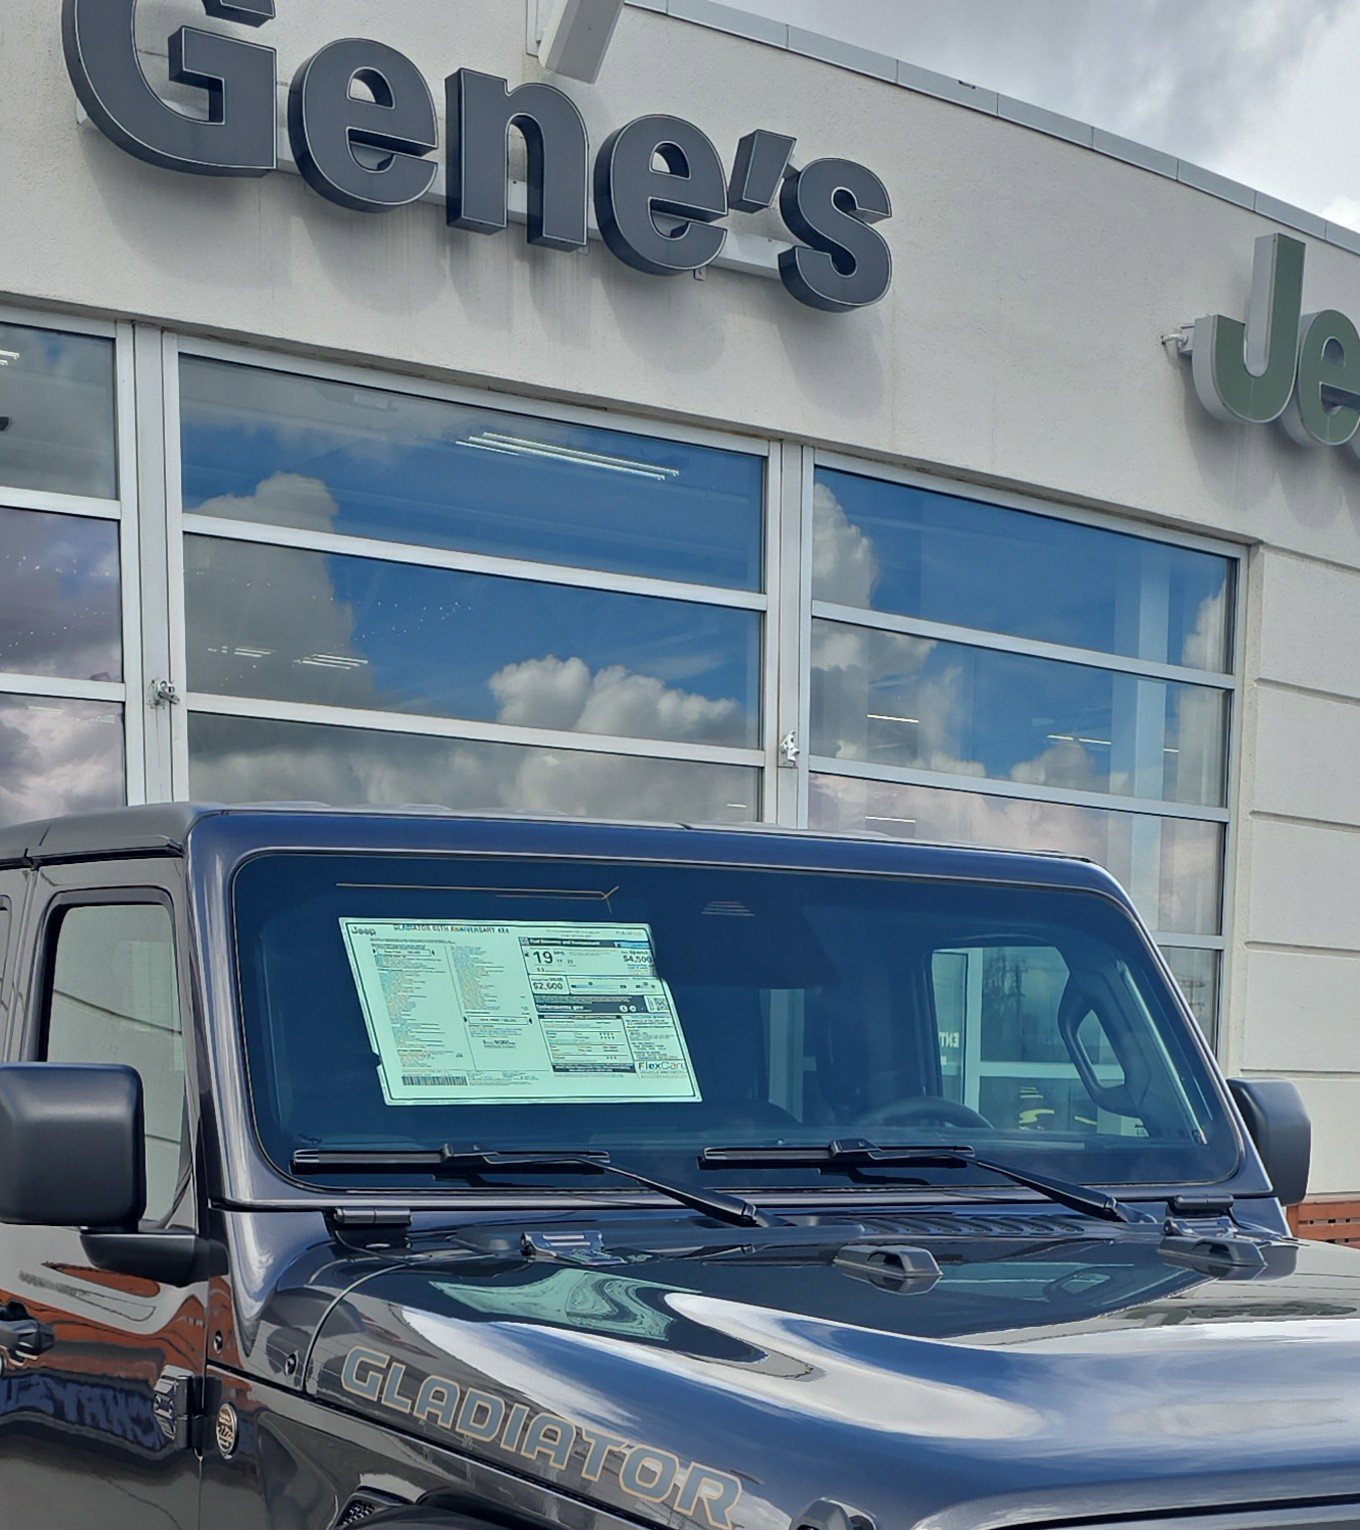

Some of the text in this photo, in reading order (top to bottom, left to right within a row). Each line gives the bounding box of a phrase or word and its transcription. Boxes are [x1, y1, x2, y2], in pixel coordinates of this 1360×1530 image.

[62, 0, 893, 313] Gene's
[351, 926, 376, 937] Jeep
[533, 951, 554, 964] 19
